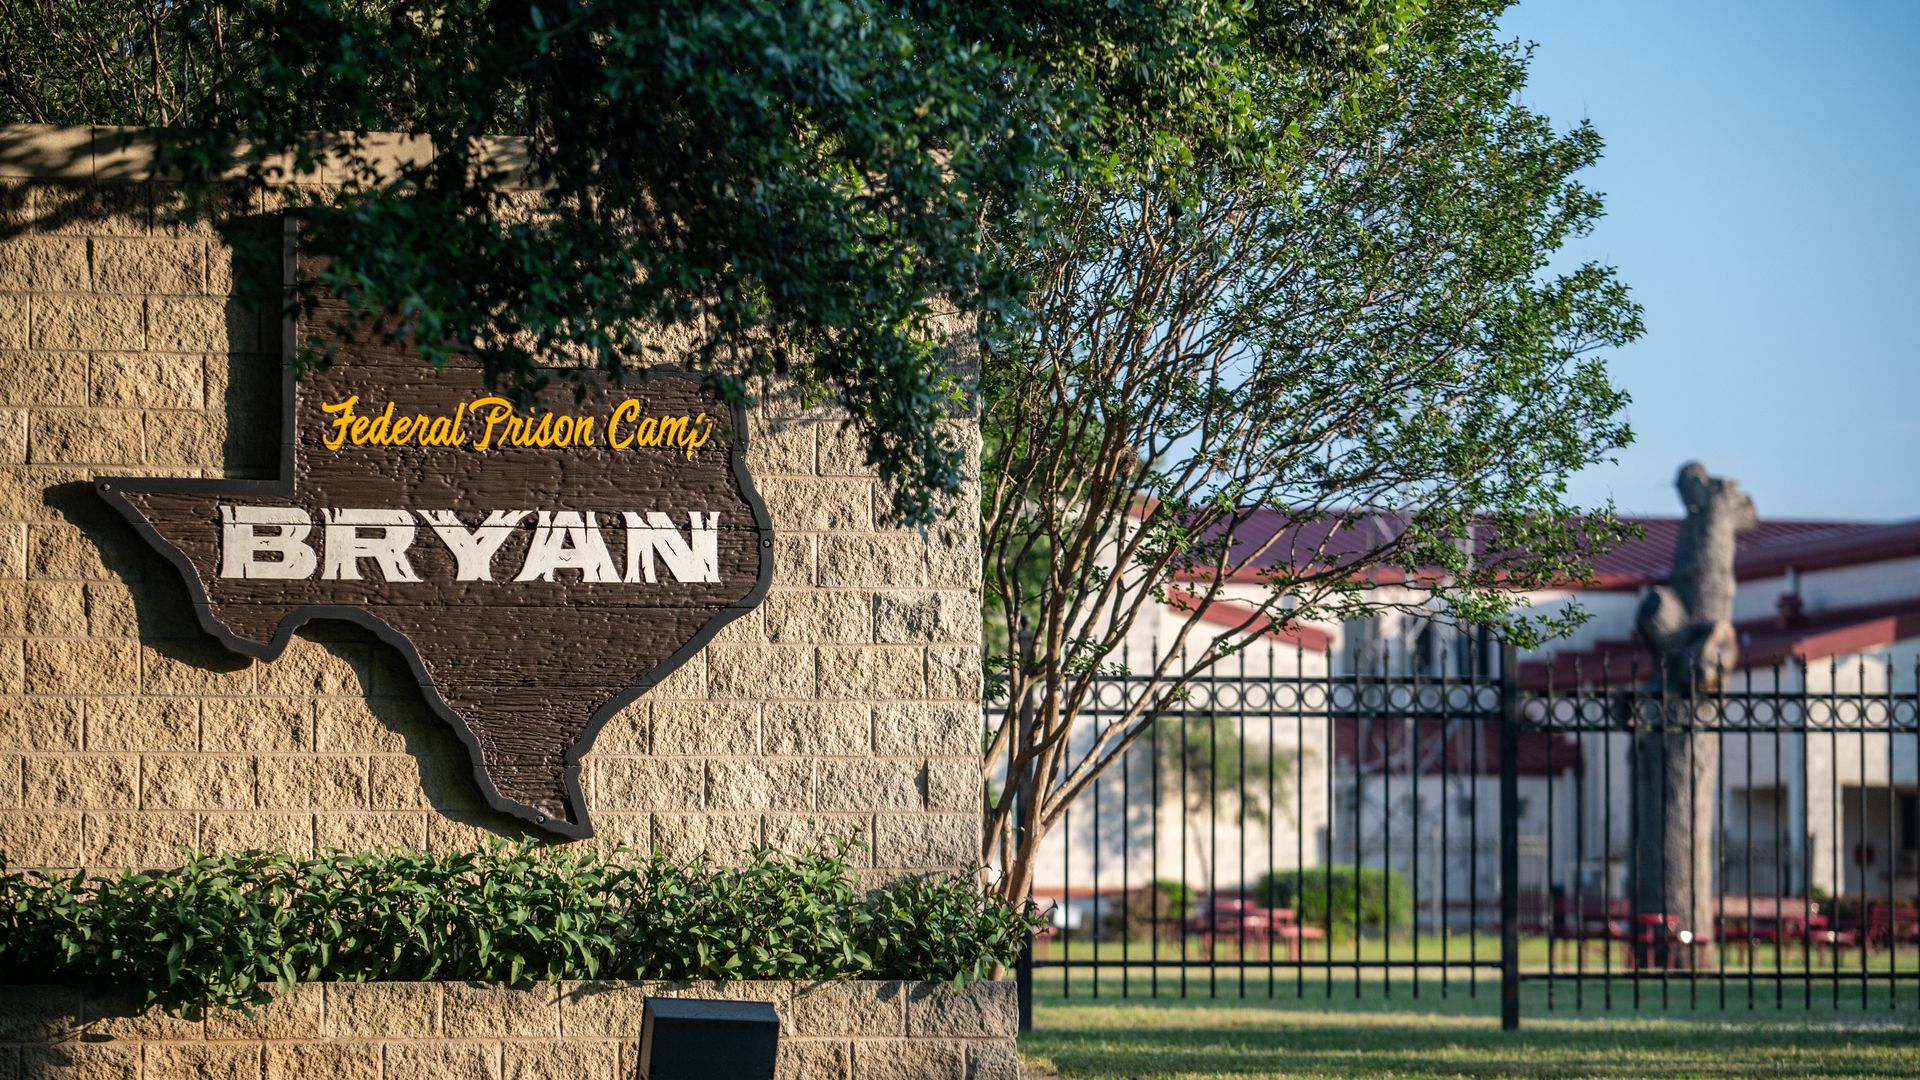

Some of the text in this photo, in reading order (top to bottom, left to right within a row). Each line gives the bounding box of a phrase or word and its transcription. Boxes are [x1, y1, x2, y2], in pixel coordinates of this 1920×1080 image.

[321, 395, 713, 462] Federal Prison Camp
[219, 504, 722, 584] BRYAN
